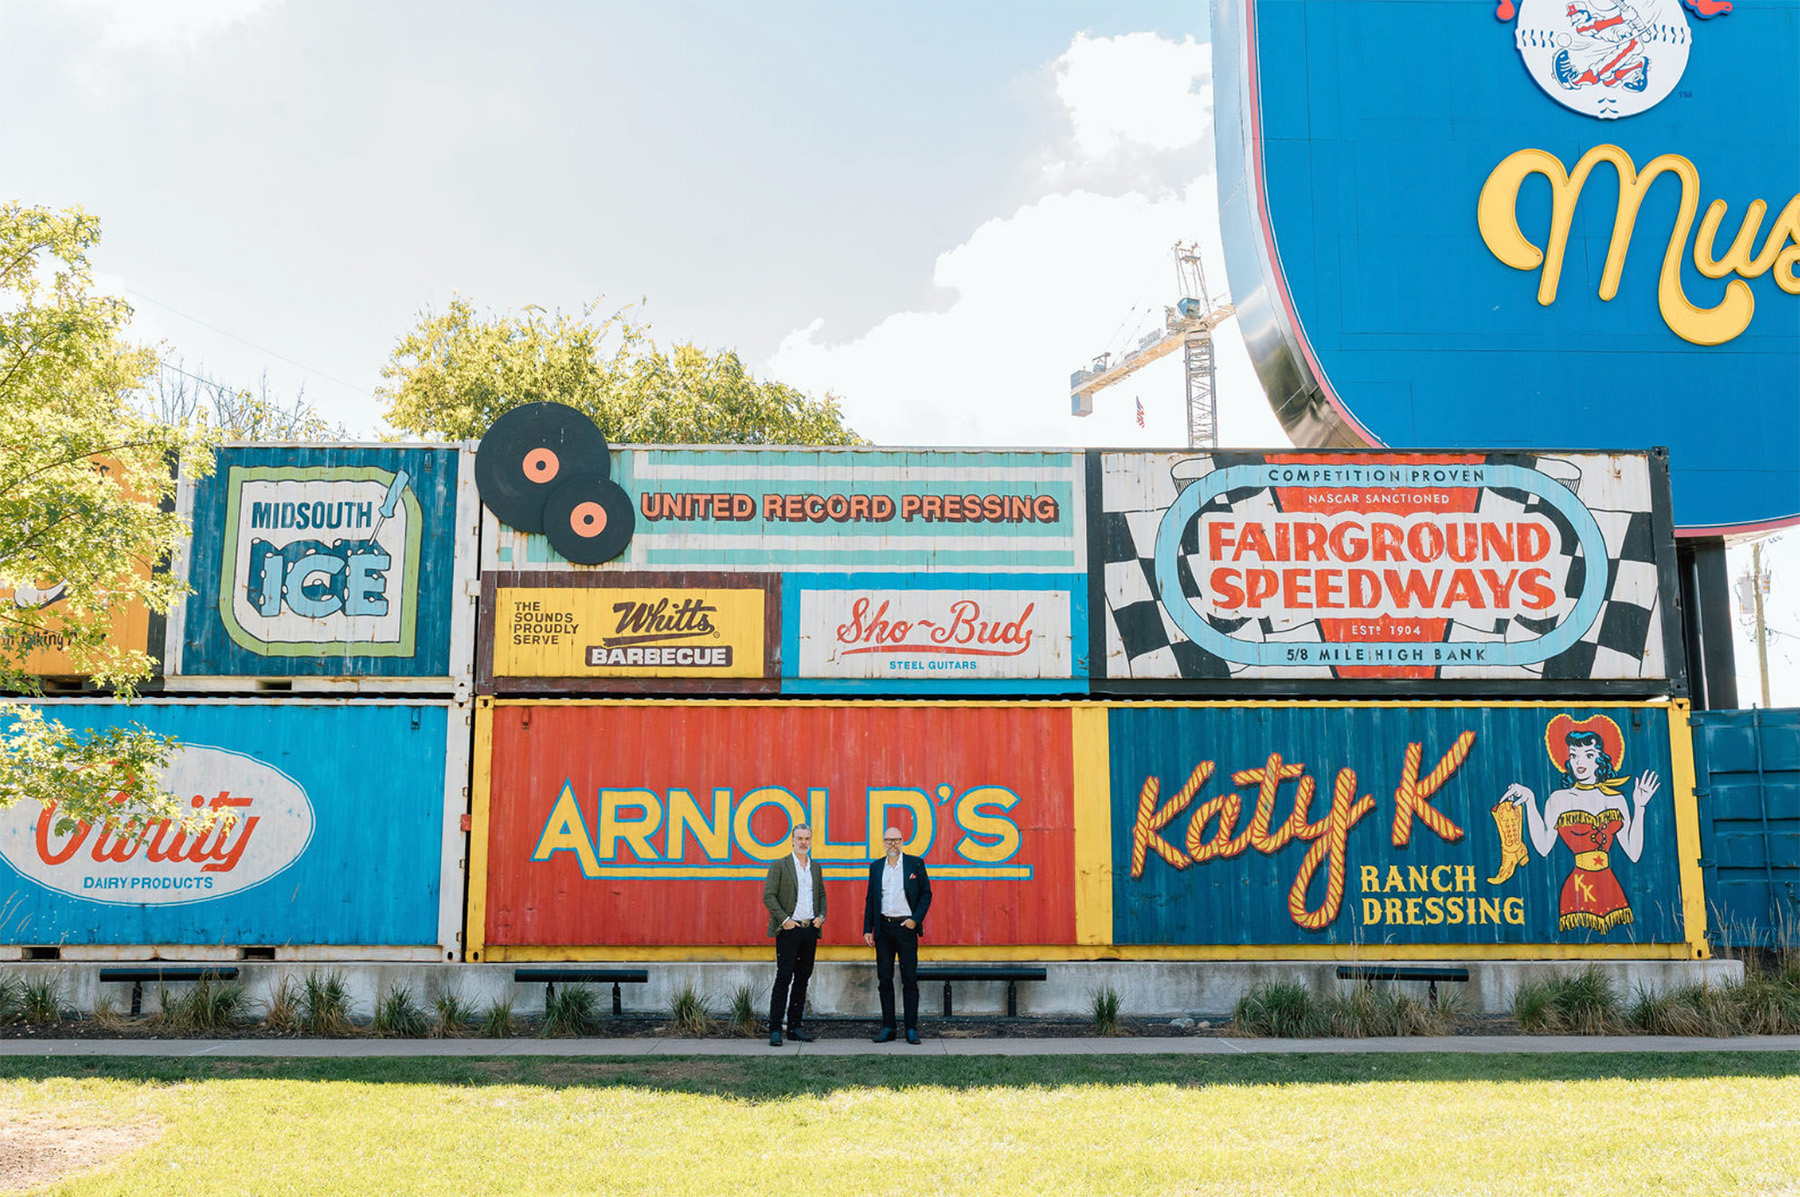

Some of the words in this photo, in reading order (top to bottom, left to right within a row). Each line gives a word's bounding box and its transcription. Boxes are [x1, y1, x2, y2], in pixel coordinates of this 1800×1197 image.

[1268, 469, 1401, 482] COMPETITION
[1411, 470, 1485, 482] PROVEN
[1308, 493, 1360, 504] NASCAR
[1365, 493, 1450, 504] SANCTIONED
[640, 492, 757, 522] UNITED
[762, 493, 897, 523] RECORD
[900, 494, 1060, 523] PRESSING
[251, 501, 373, 530] MIDSOUTH
[1208, 520, 1551, 563] FAIRGROUND
[247, 537, 391, 619] ICE
[1209, 567, 1556, 610] SPEEDWAYS
[513, 601, 541, 612] THE
[513, 612, 574, 623] SOUNDS
[513, 623, 579, 635] PROUDLY
[1390, 625, 1421, 635] 1904
[513, 634, 560, 645] SERVE
[591, 648, 727, 665] BARBECUE
[1286, 648, 1309, 661] 5/8
[1319, 648, 1364, 660] MILE
[1375, 648, 1423, 660] HIGH
[1434, 648, 1485, 660] BANK
[889, 661, 925, 670] STEEL
[928, 661, 977, 670] GUITARS
[530, 777, 1022, 864] ARNOLD'S
[1130, 751, 1376, 930] Katy
[1391, 730, 1476, 846] K
[83, 876, 128, 889] DAIRY
[130, 876, 213, 889] PRODUCTS
[1361, 865, 1476, 893] RANCH
[1361, 897, 1525, 926] DRESSING
